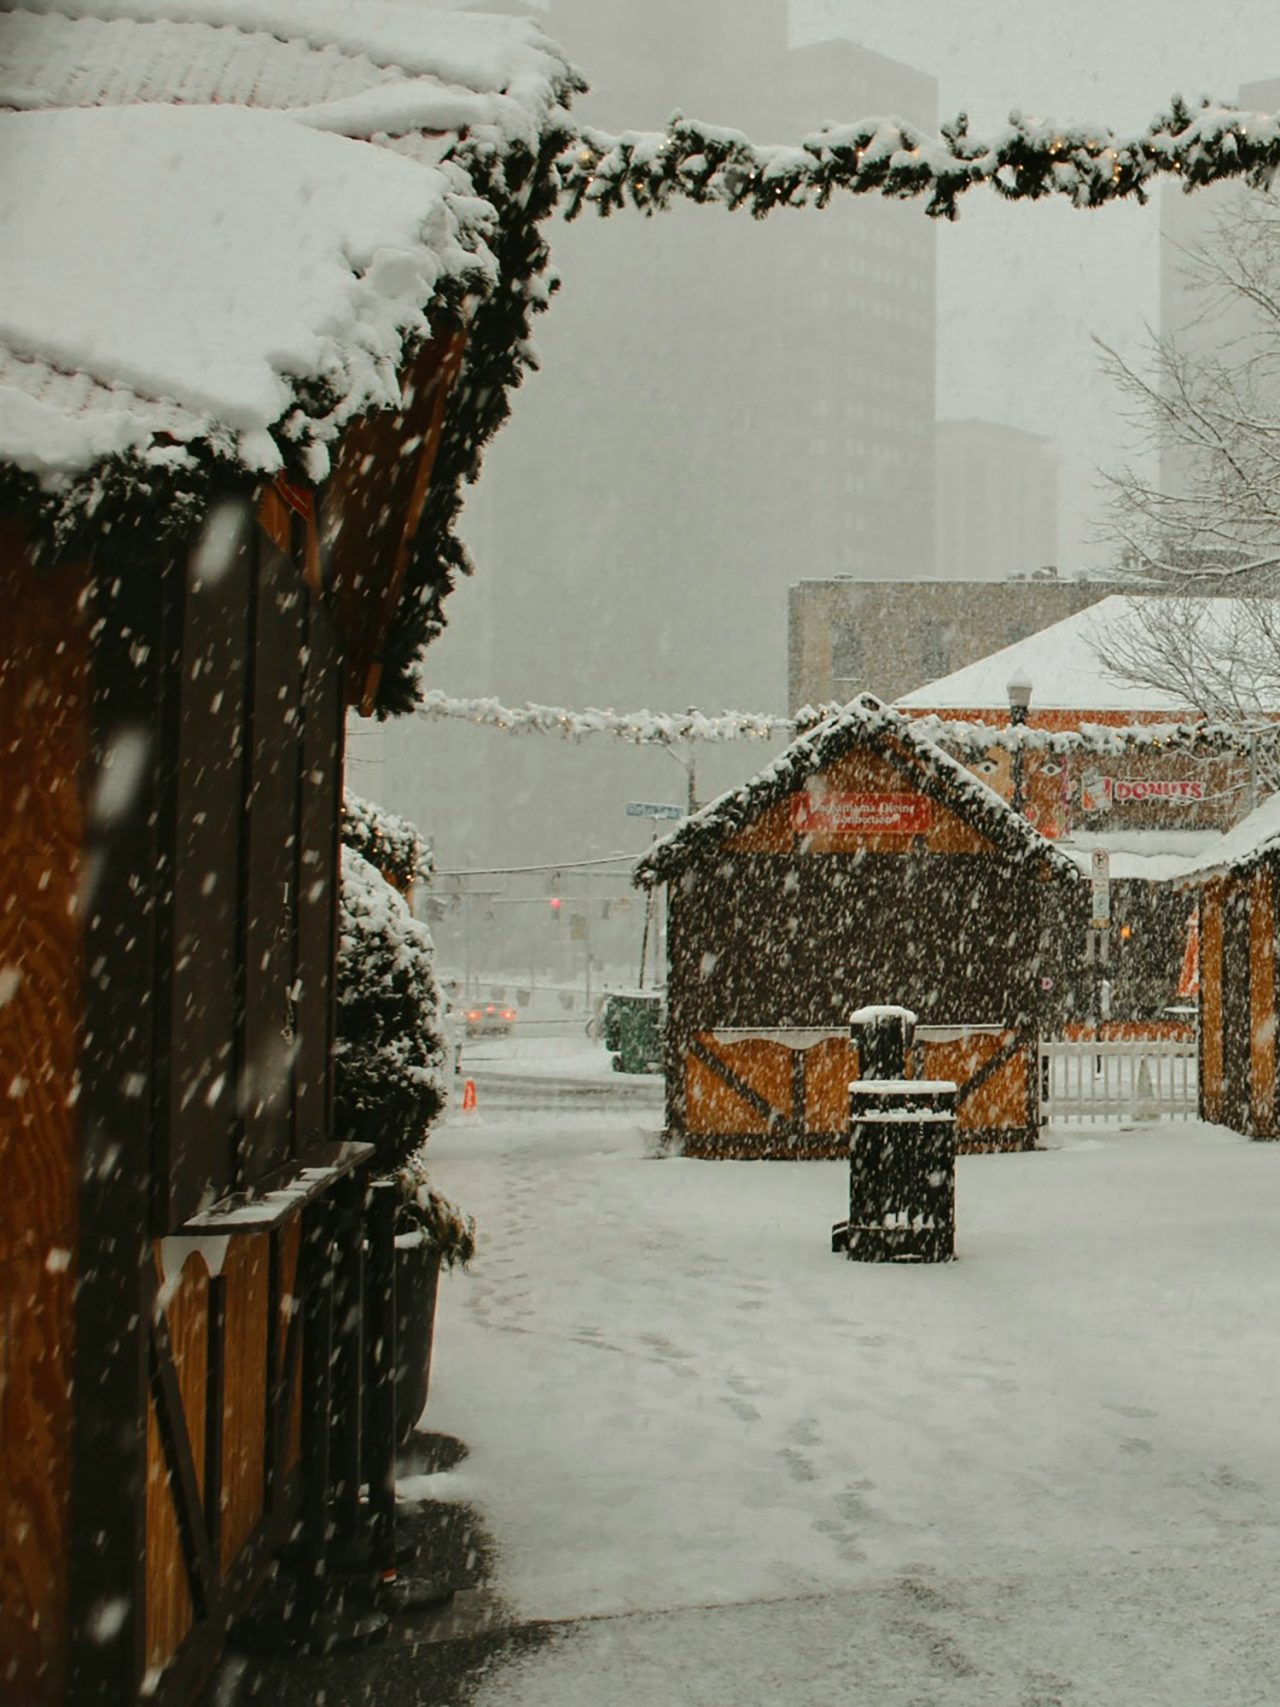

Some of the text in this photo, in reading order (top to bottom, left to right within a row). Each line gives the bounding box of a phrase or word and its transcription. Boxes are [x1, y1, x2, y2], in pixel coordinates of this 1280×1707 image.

[1115, 781, 1203, 799] DONUTS
[811, 802, 876, 815] achamama
[832, 814, 900, 825] Connectio
